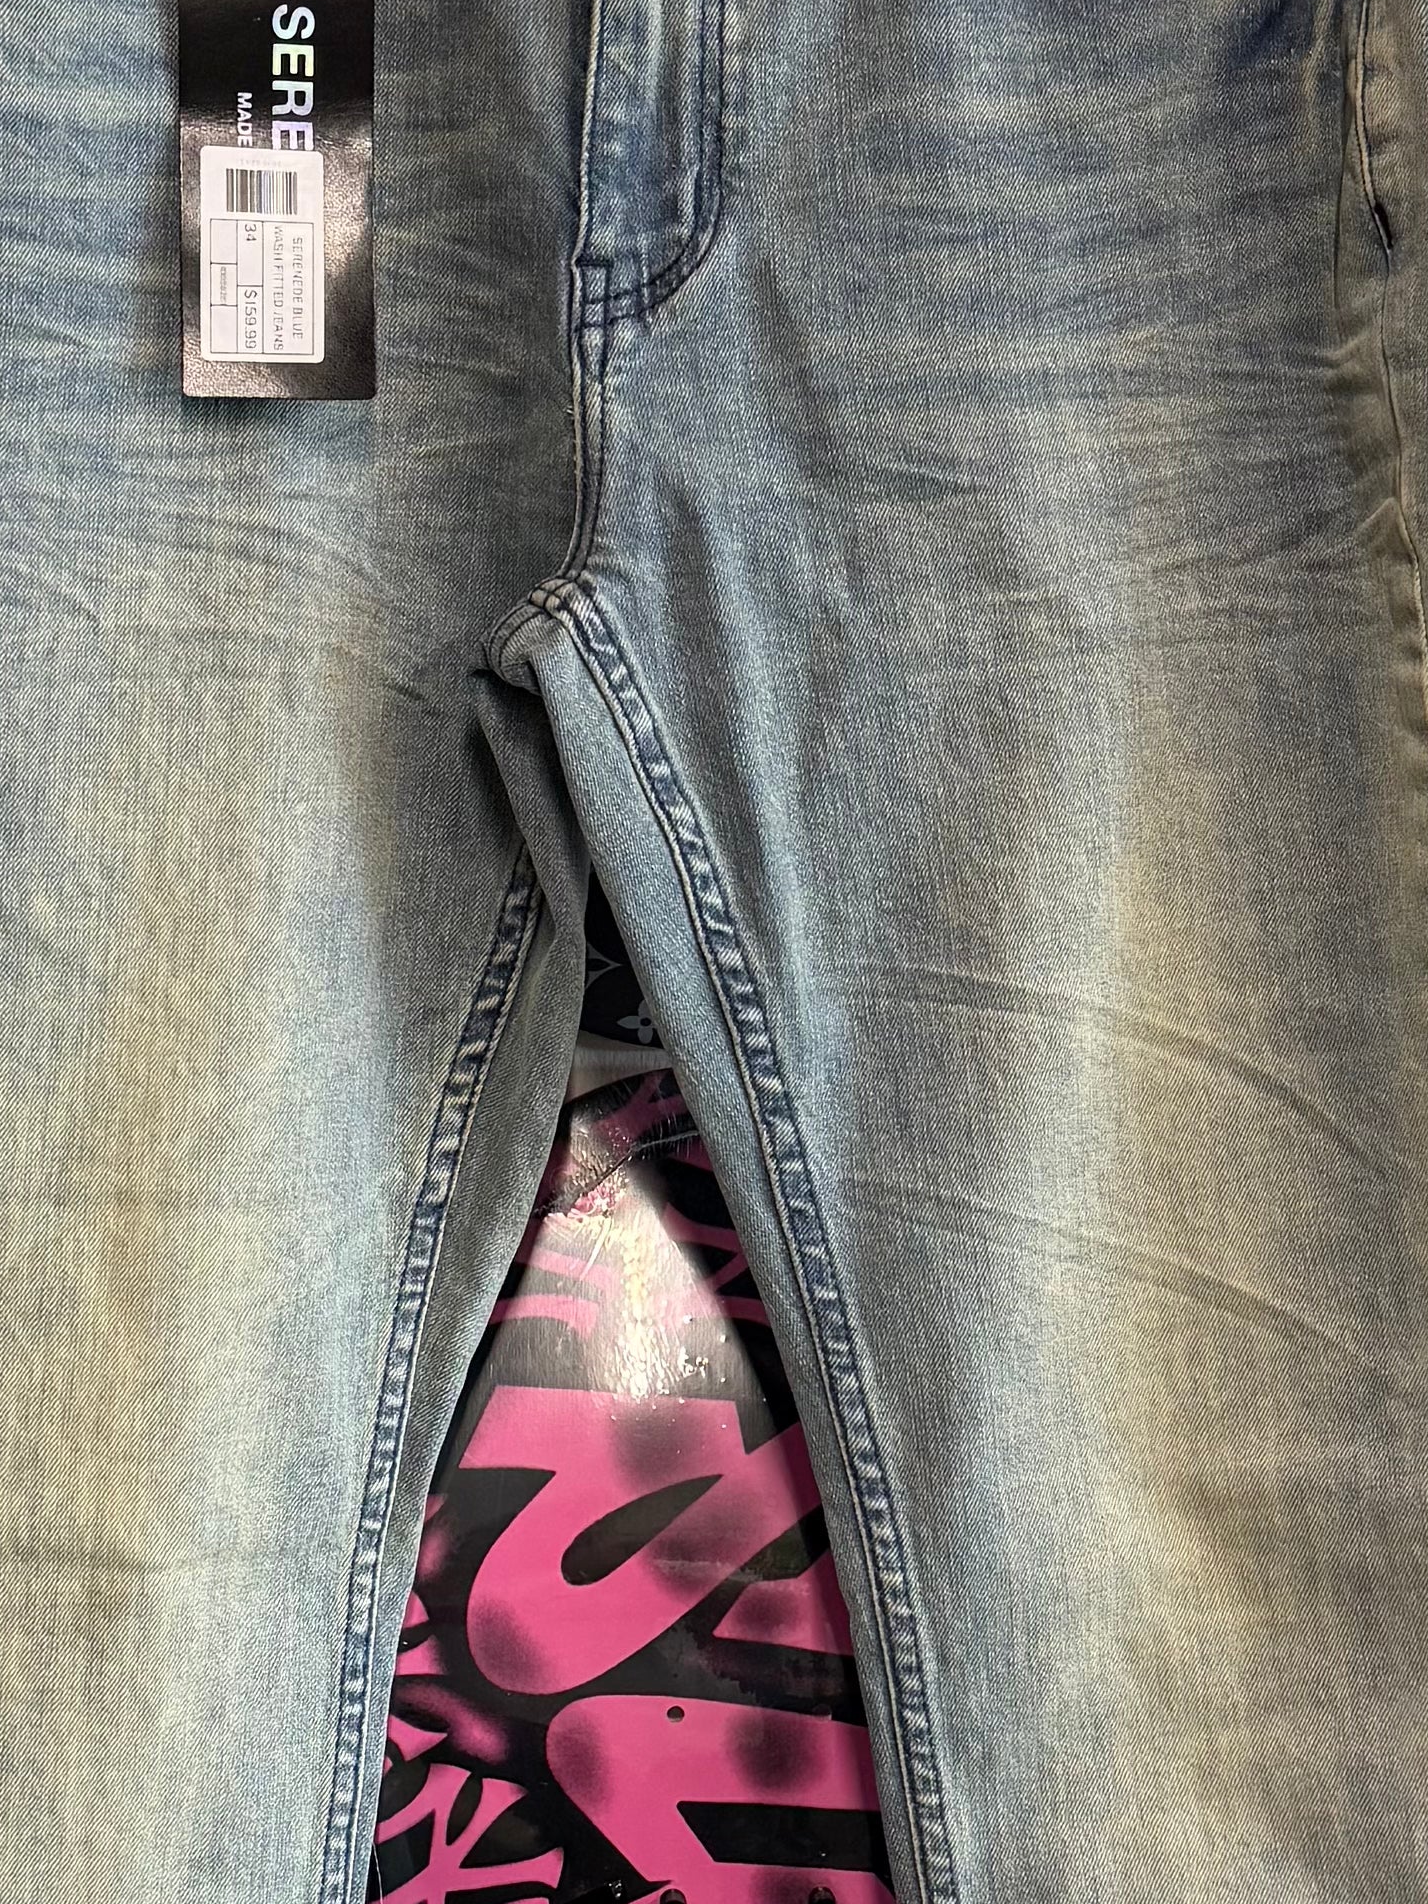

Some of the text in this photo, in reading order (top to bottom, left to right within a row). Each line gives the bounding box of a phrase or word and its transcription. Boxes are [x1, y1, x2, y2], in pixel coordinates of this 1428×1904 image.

[237, 91, 253, 147] MADE
[243, 223, 258, 349] 34 $159.99
[272, 225, 284, 351] WASH FITTED JEANS
[291, 236, 305, 340] SERENEDE BLUE
